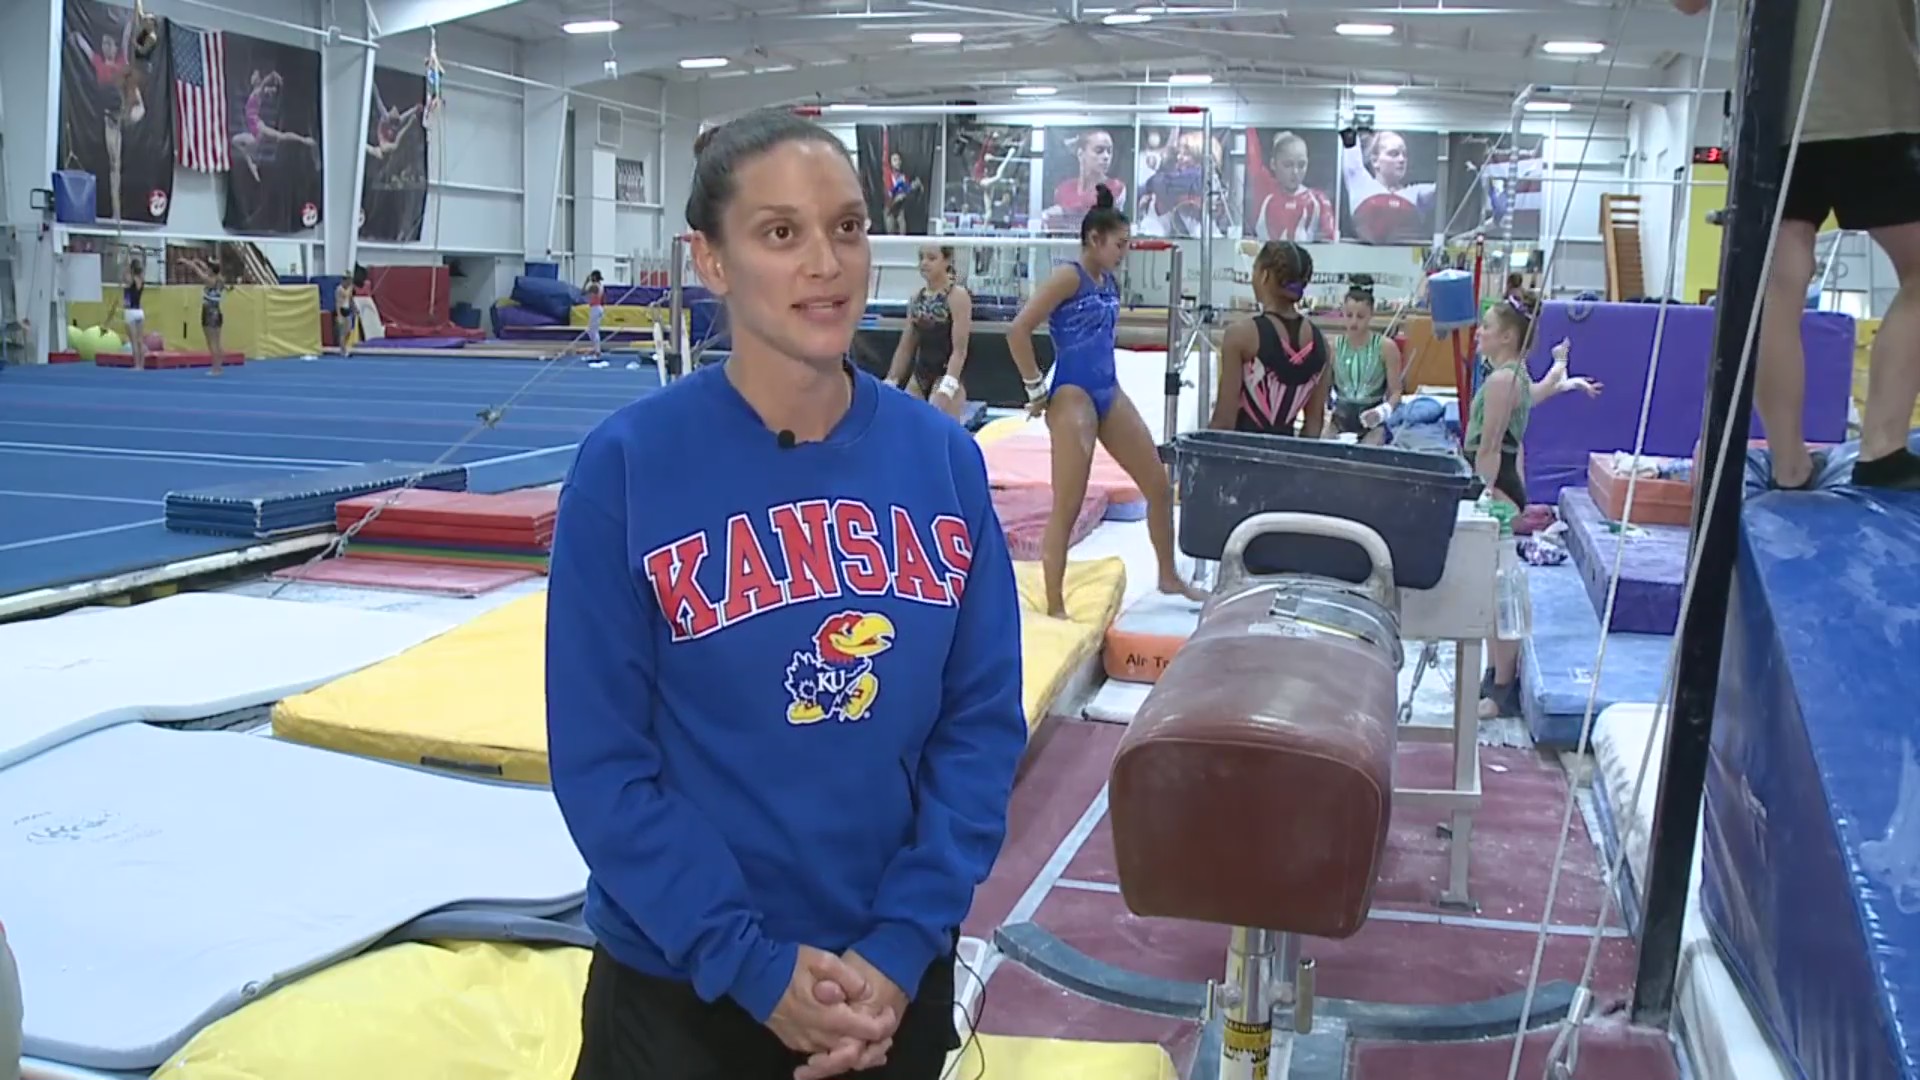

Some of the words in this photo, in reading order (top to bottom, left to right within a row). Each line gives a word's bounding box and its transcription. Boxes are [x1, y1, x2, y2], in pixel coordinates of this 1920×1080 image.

[643, 499, 973, 643] KANSAS
[1126, 653, 1147, 667] Air
[816, 670, 846, 693] KU
